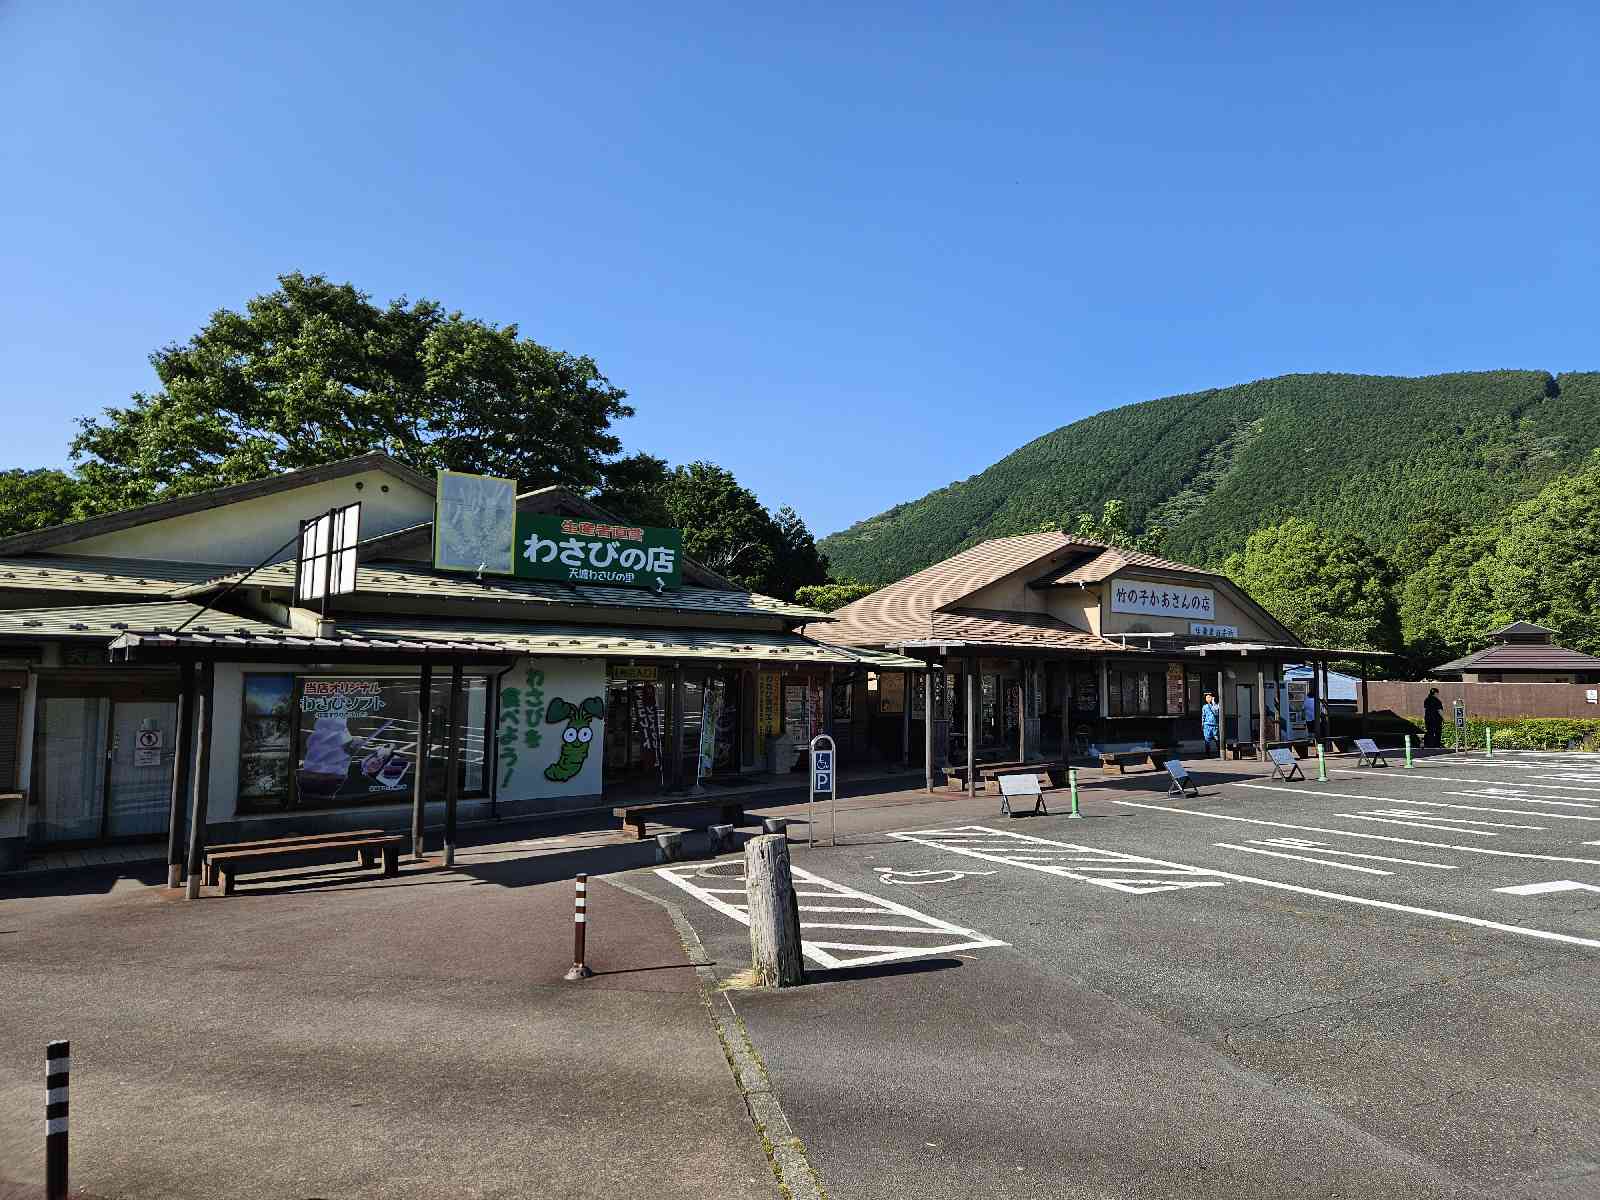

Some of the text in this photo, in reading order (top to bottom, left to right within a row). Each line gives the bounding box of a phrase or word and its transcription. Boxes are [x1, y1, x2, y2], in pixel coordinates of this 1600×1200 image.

[523, 533, 675, 574] わさびの店
[568, 567, 635, 583] 天城わさびの里
[1116, 587, 1210, 612] 竹の子かあさんの店
[303, 681, 382, 695] 当店オリジナル
[299, 696, 386, 713] わさびソフト
[526, 669, 545, 749] わさびを
[817, 773, 828, 790] P
